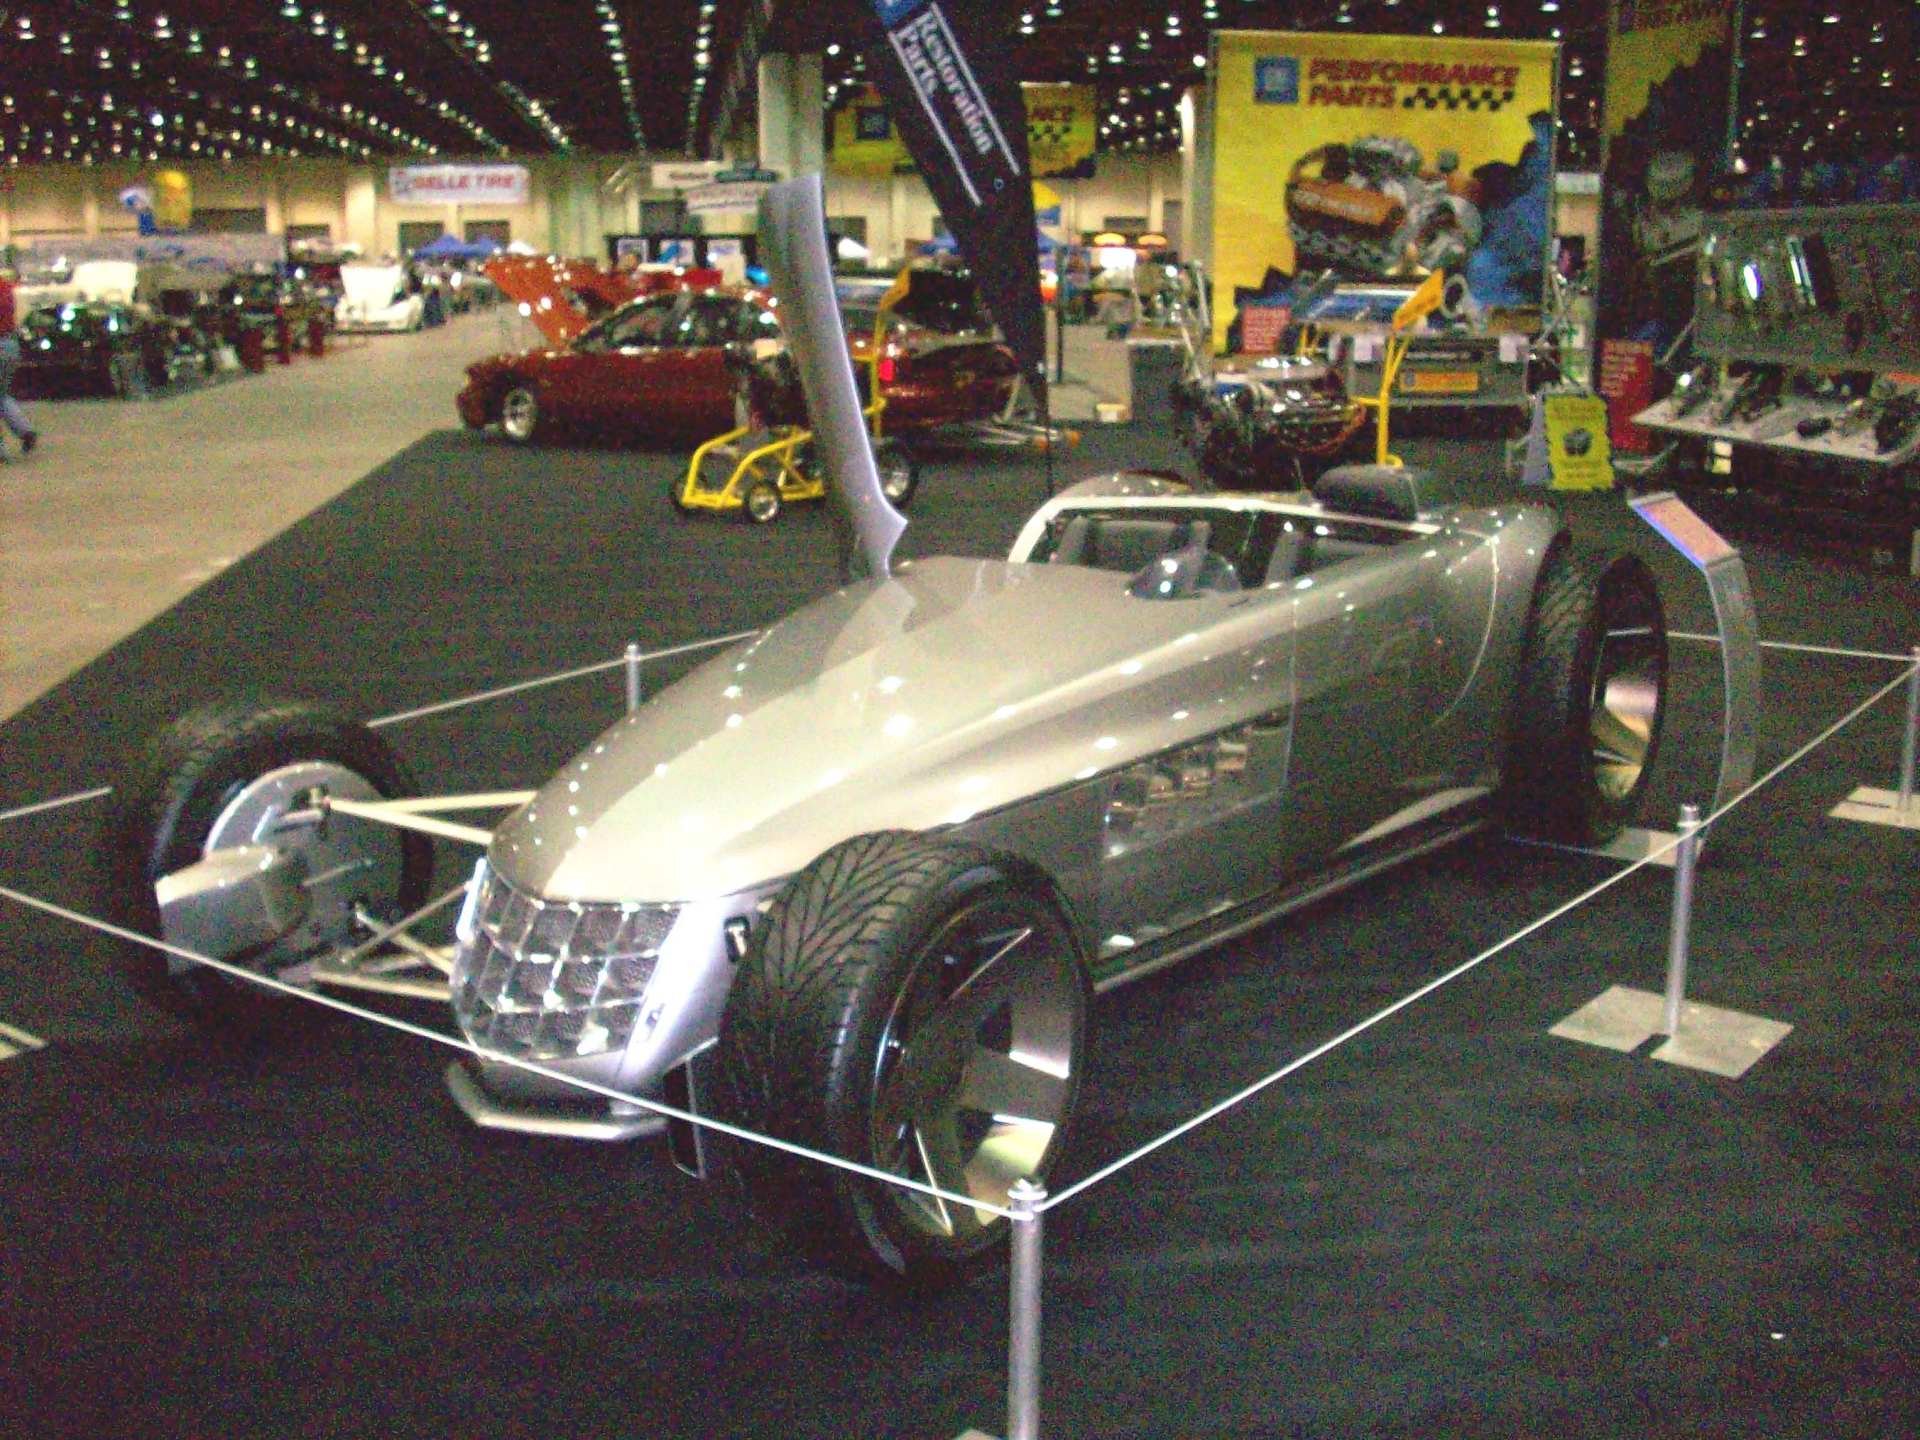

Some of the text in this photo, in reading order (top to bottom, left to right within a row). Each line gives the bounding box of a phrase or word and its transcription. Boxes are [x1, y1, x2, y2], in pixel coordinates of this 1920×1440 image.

[896, 25, 939, 95] Parts
[1308, 57, 1520, 88] PERFORMANCE
[917, 13, 994, 156] Restoration
[1308, 84, 1397, 107] PARTS
[476, 173, 516, 189] TIRE
